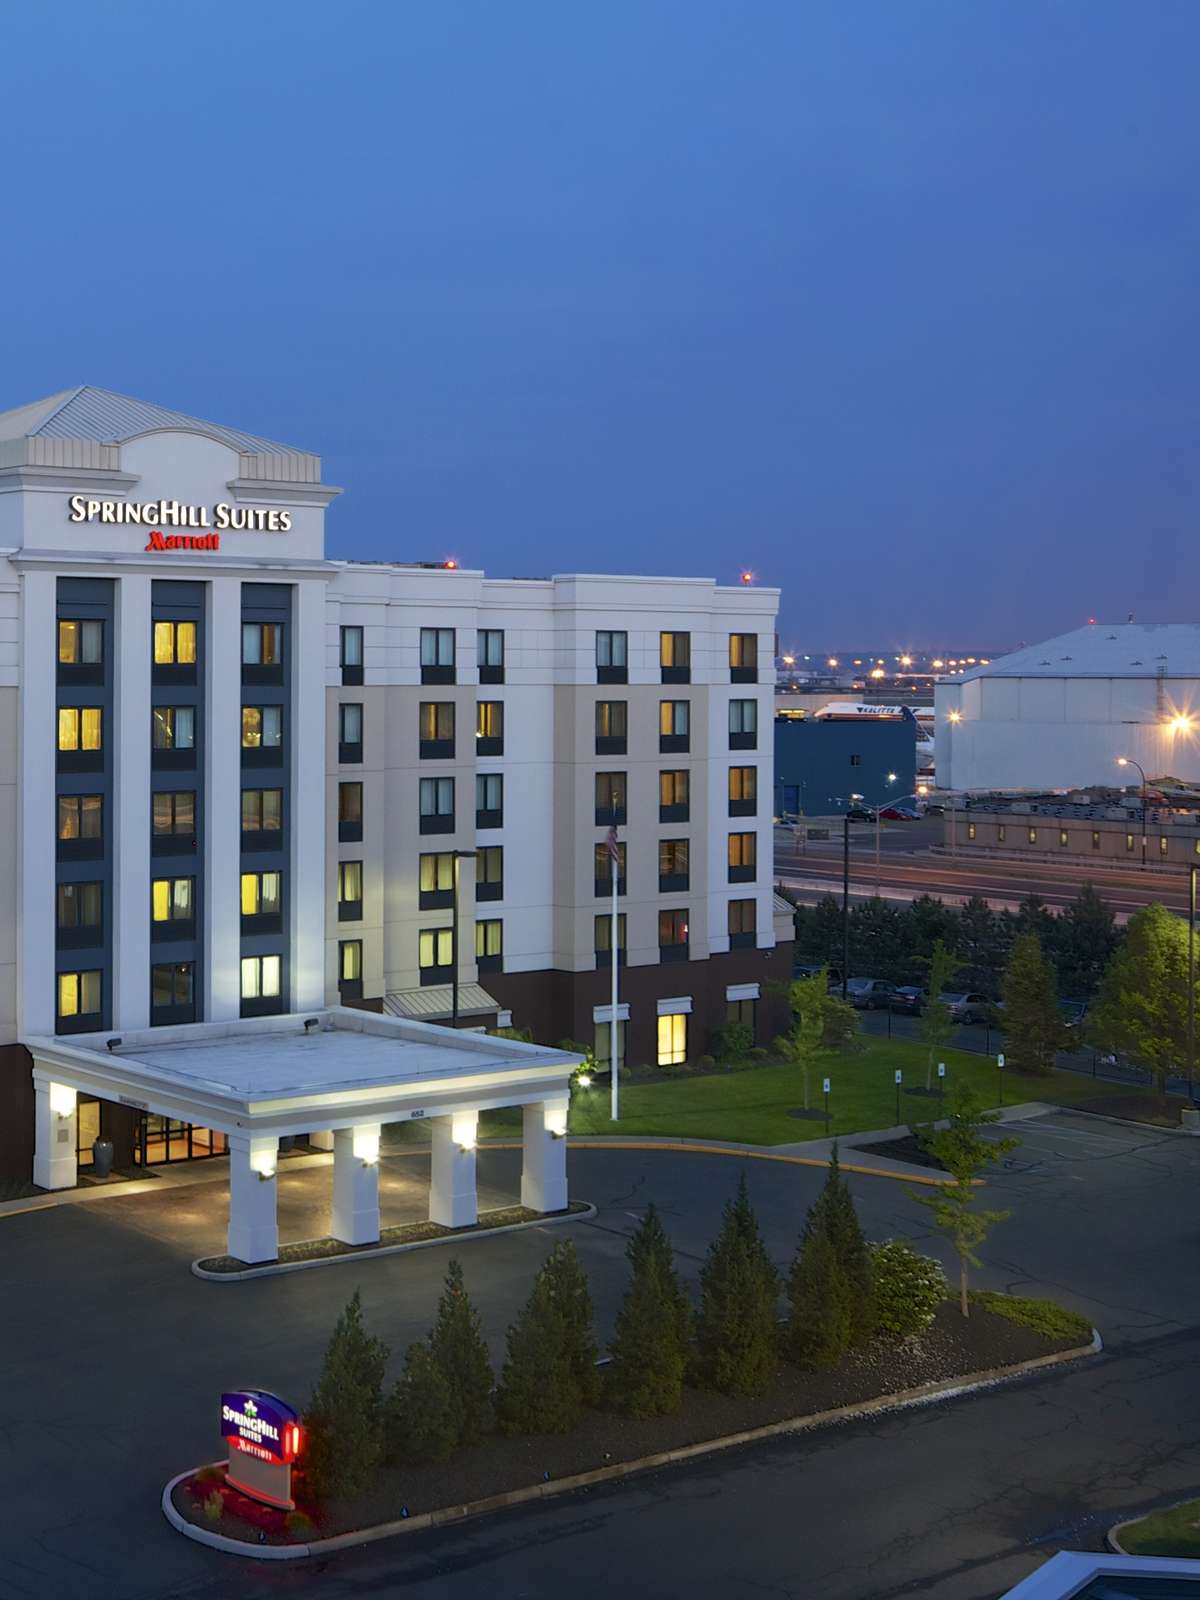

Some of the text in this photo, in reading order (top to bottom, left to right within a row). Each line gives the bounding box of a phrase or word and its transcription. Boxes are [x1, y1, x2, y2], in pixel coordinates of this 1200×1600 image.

[70, 495, 292, 531] SPRINGHILL SUITES
[145, 530, 220, 551] Marriott
[222, 1405, 279, 1440] SPRINGHILL
[239, 1427, 262, 1443] SUITES
[237, 1439, 272, 1461] Marriott
